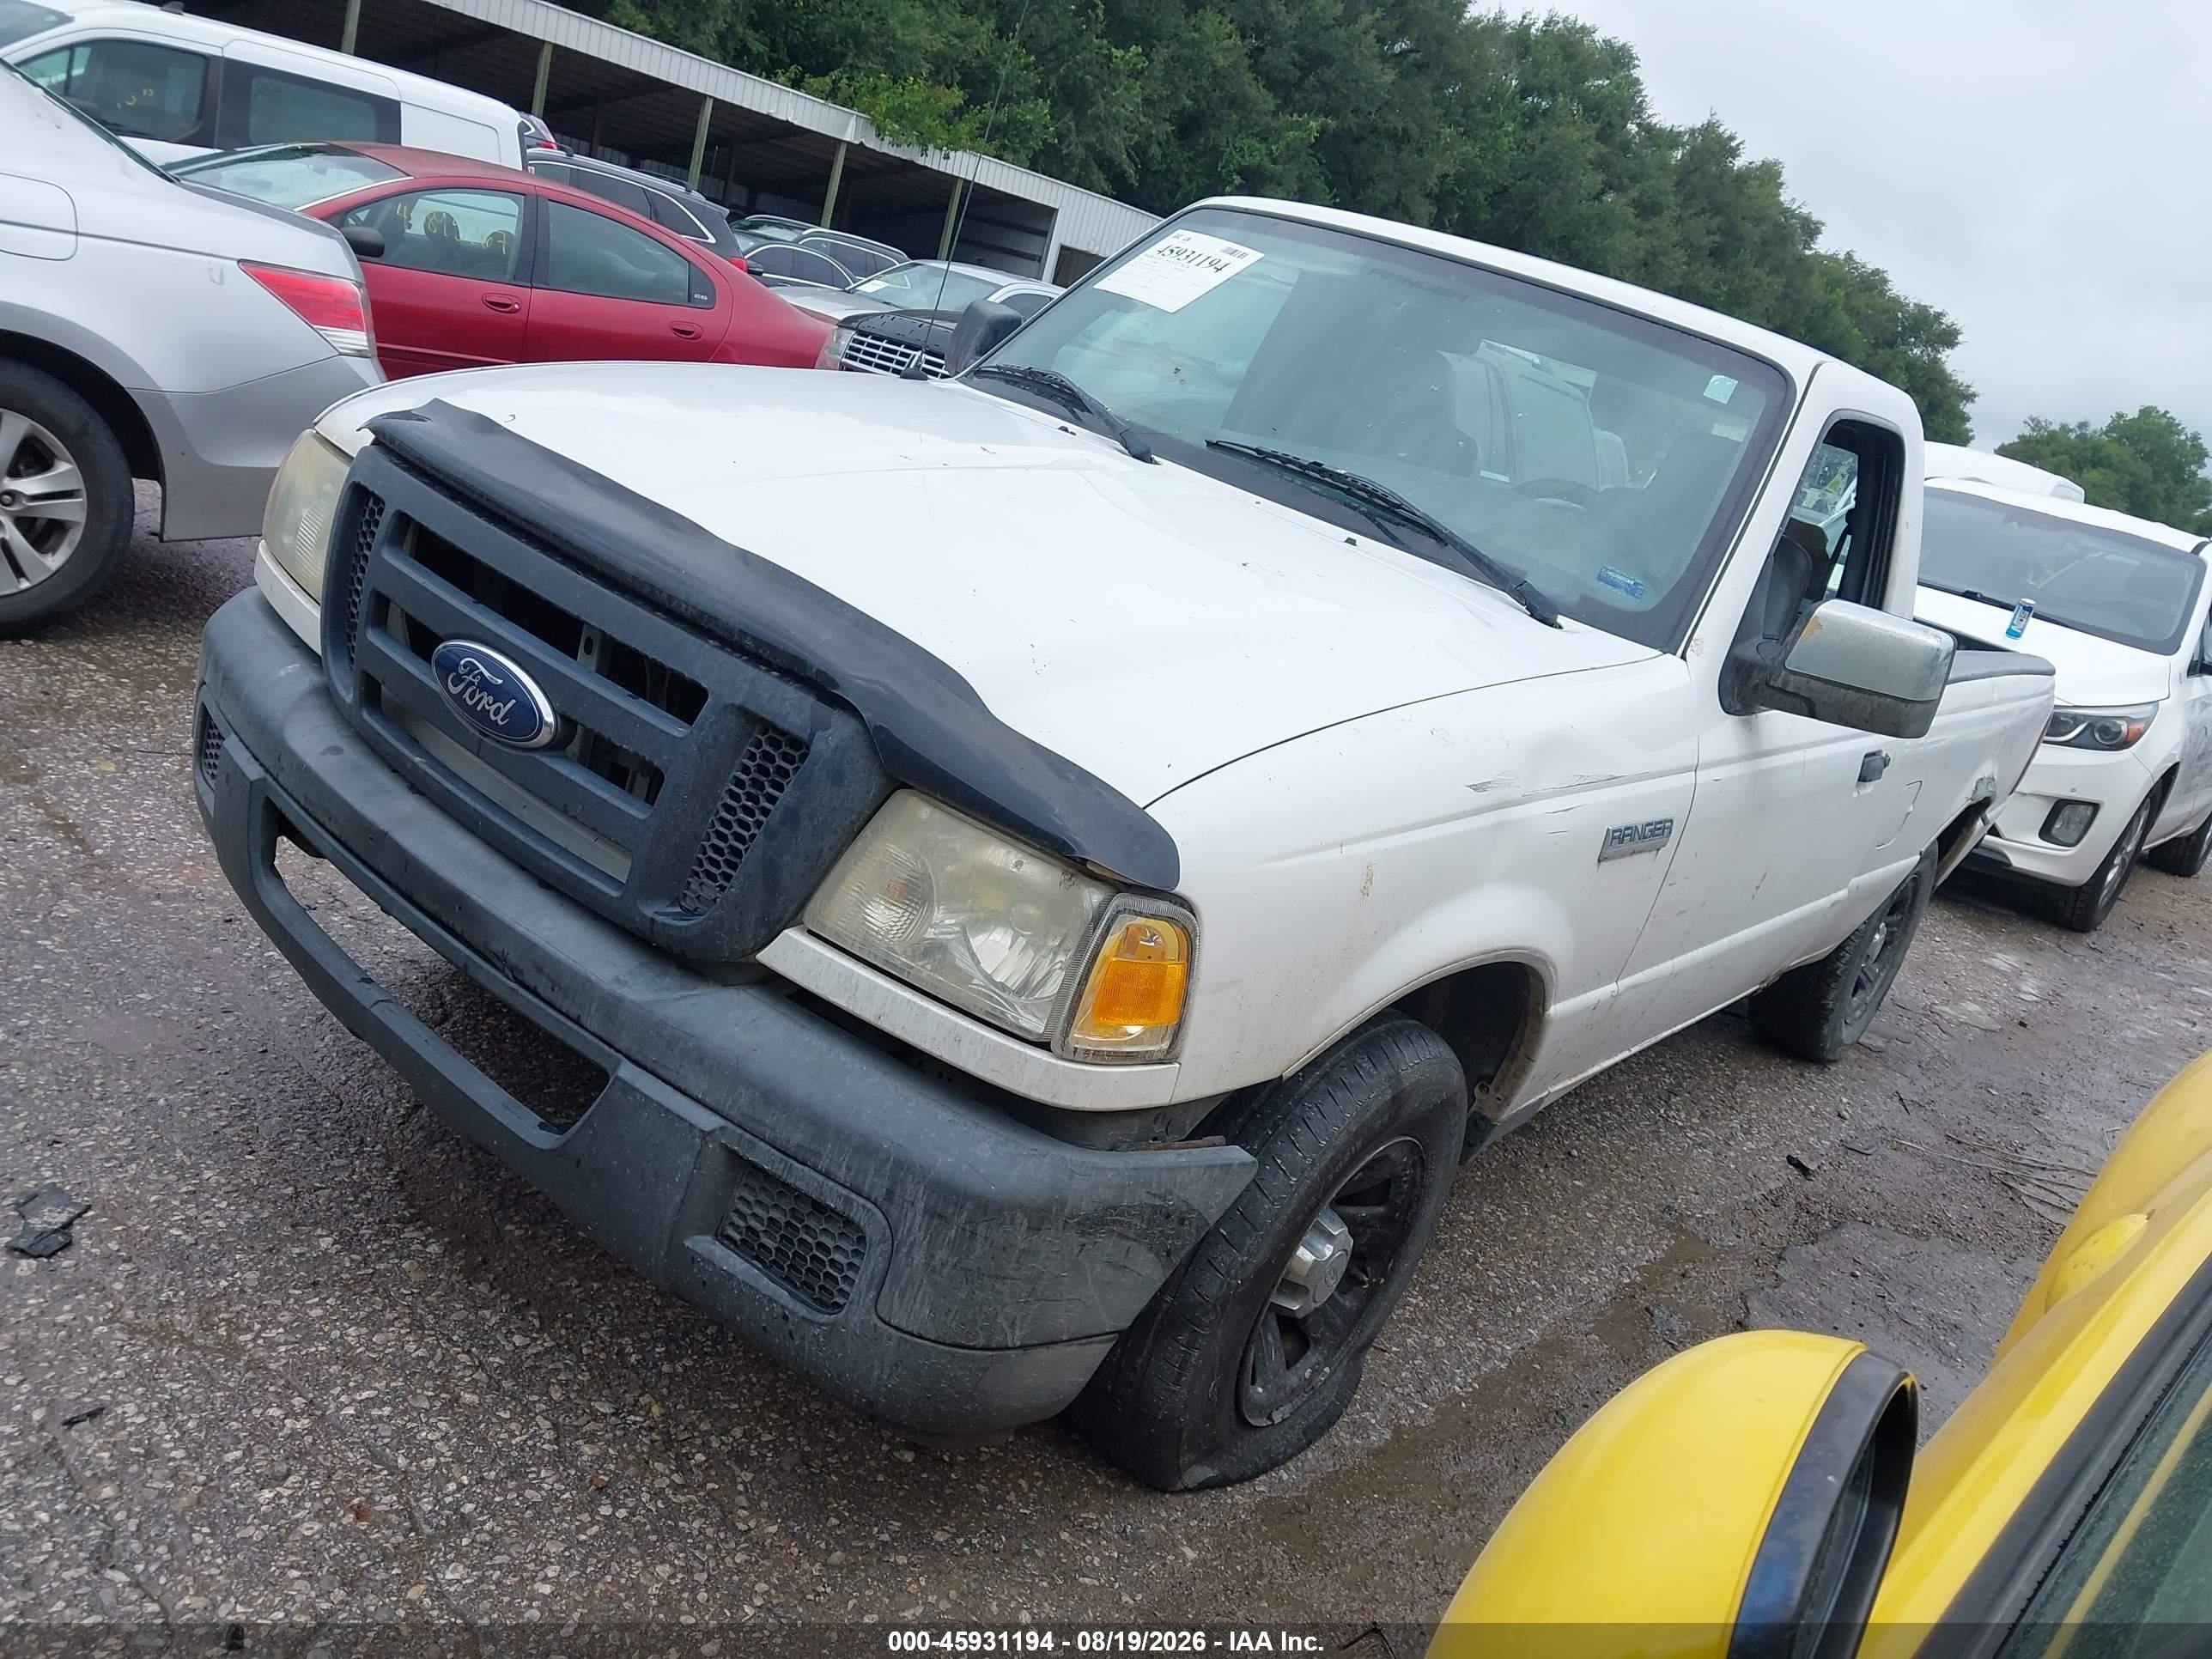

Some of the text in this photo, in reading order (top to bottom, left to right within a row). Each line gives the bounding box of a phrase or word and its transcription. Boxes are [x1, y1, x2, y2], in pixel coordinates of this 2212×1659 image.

[1156, 244, 1231, 273] 45931194
[447, 658, 517, 726] Ford
[1608, 818, 1674, 847] RANGER
